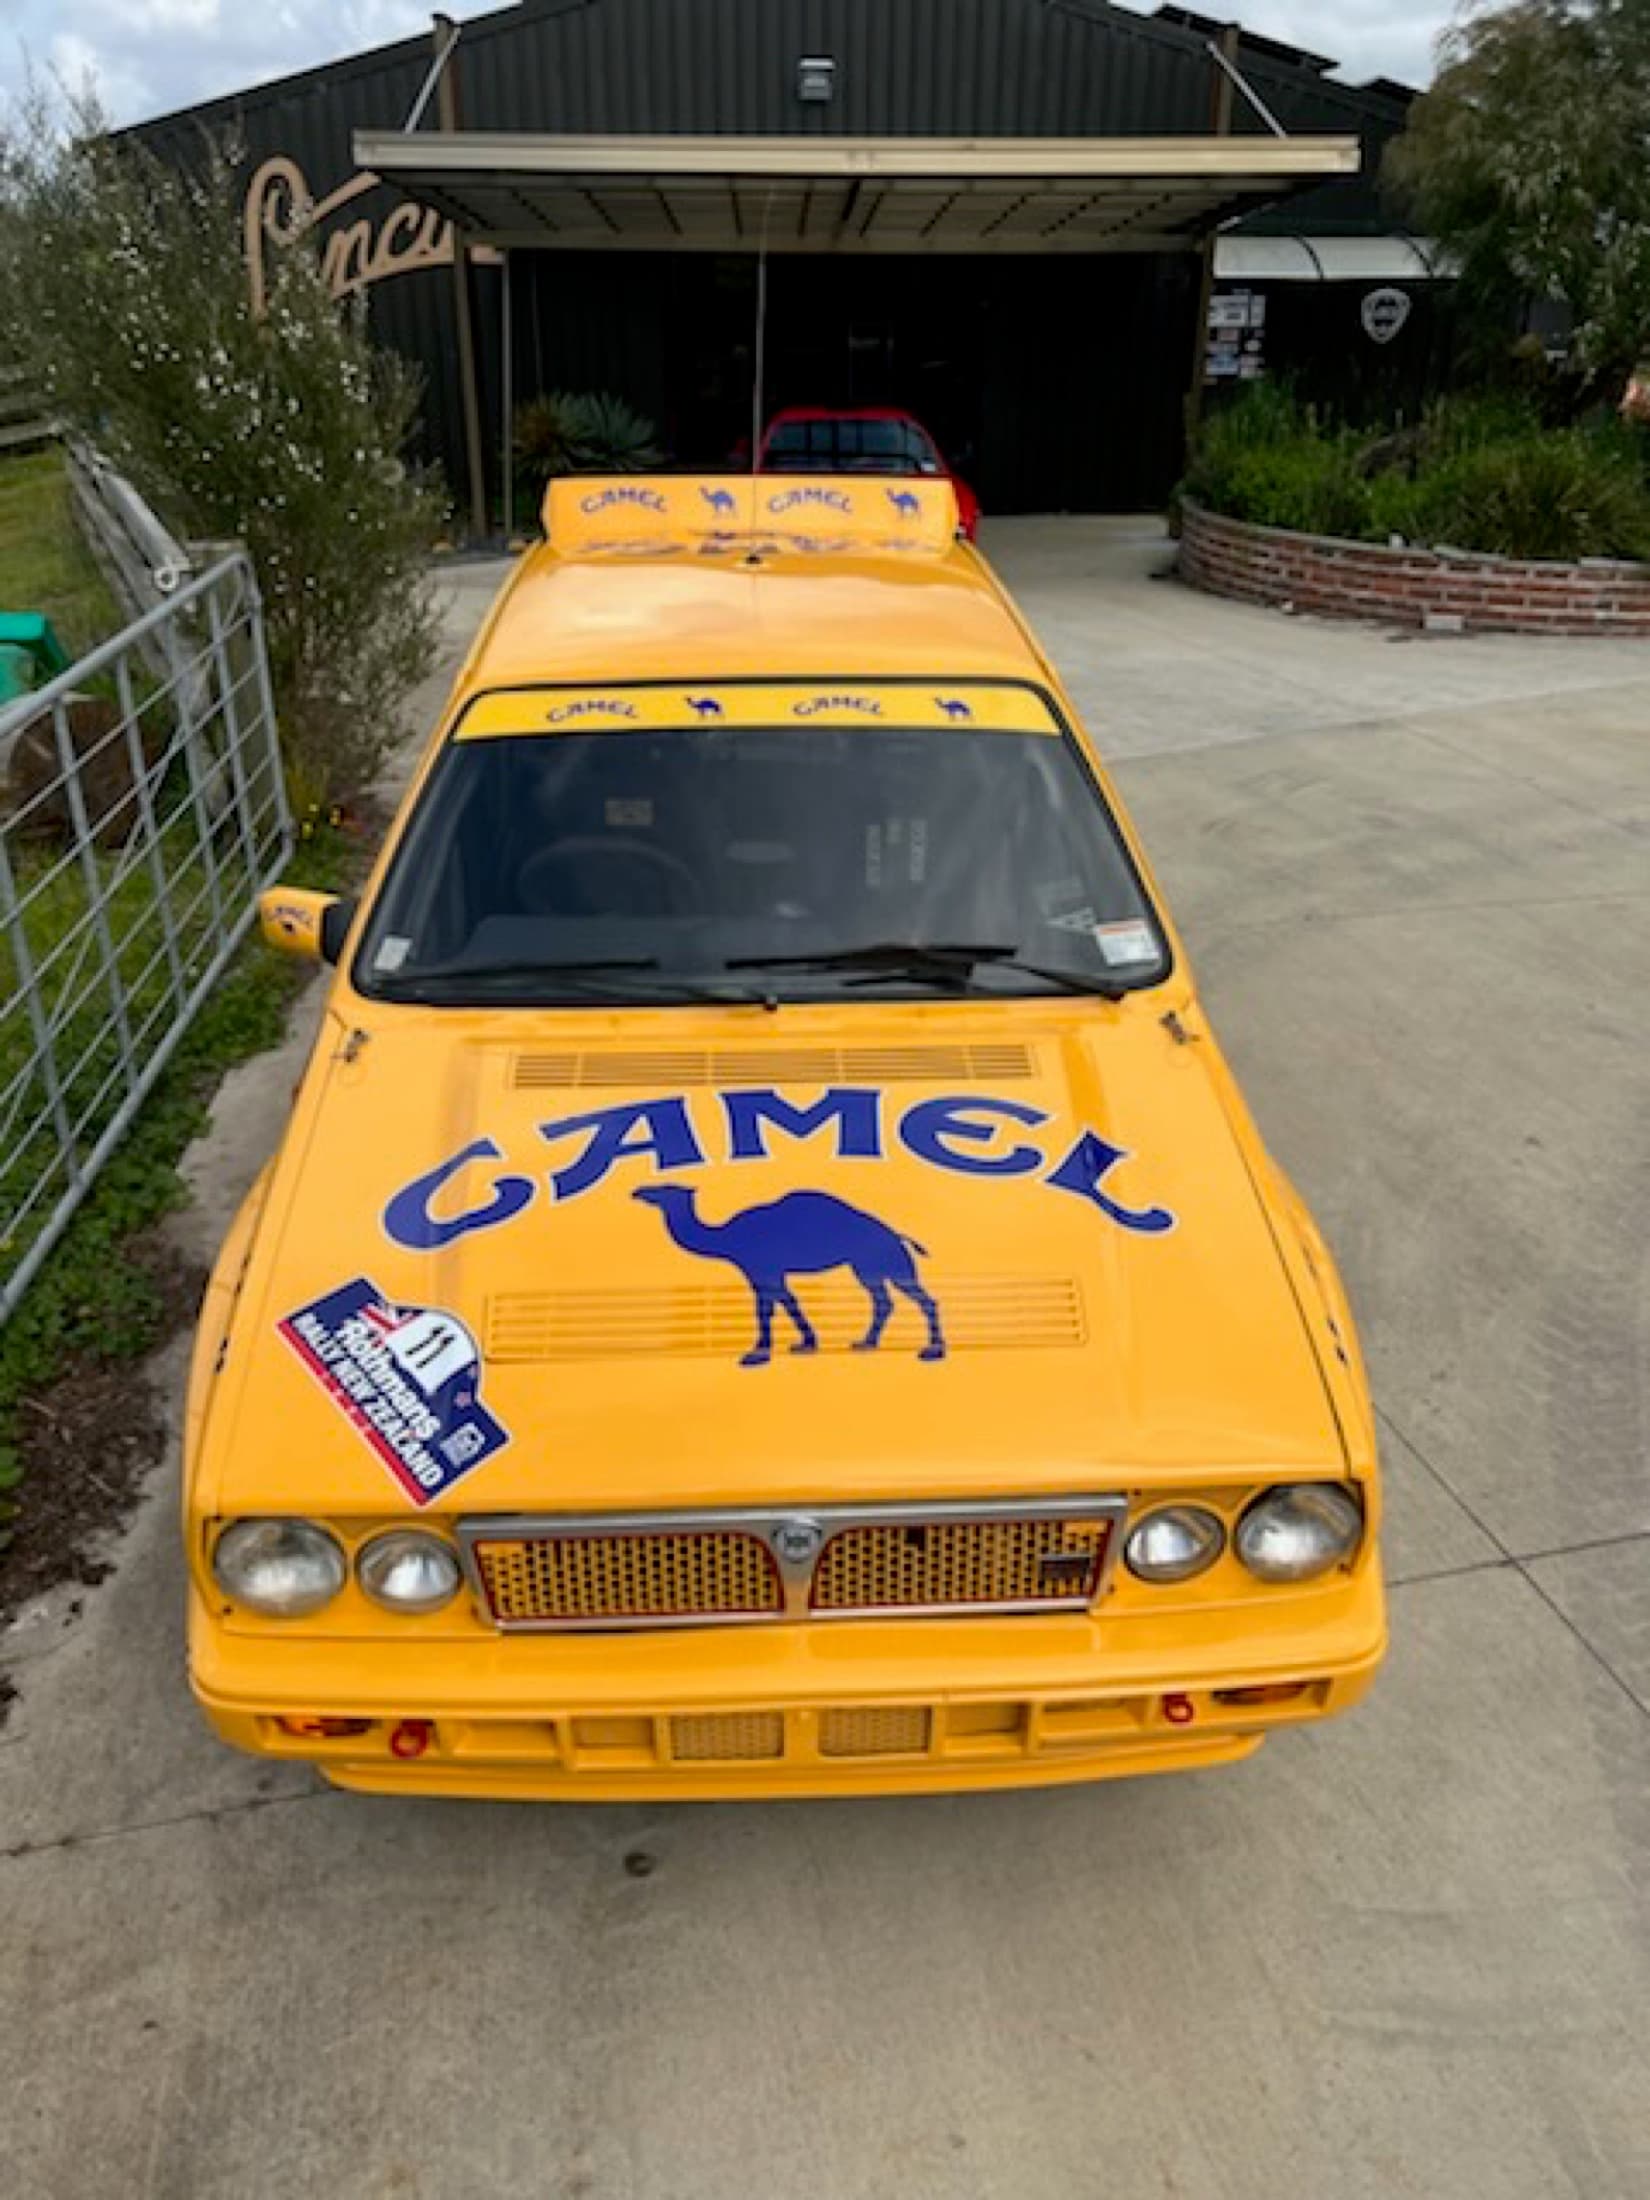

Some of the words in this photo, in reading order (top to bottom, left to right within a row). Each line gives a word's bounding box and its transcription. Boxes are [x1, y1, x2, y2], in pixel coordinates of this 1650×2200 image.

[580, 486, 667, 515] CAMEL
[768, 486, 853, 515] CAMEL
[546, 700, 638, 724] CAMEL
[793, 695, 884, 718] CAMEL
[383, 1088, 1173, 1250] CAMEL
[405, 1324, 454, 1369] 11
[335, 1318, 442, 1442] Rothmans
[329, 1357, 379, 1401] NEW
[363, 1395, 446, 1487] ZEALAND
